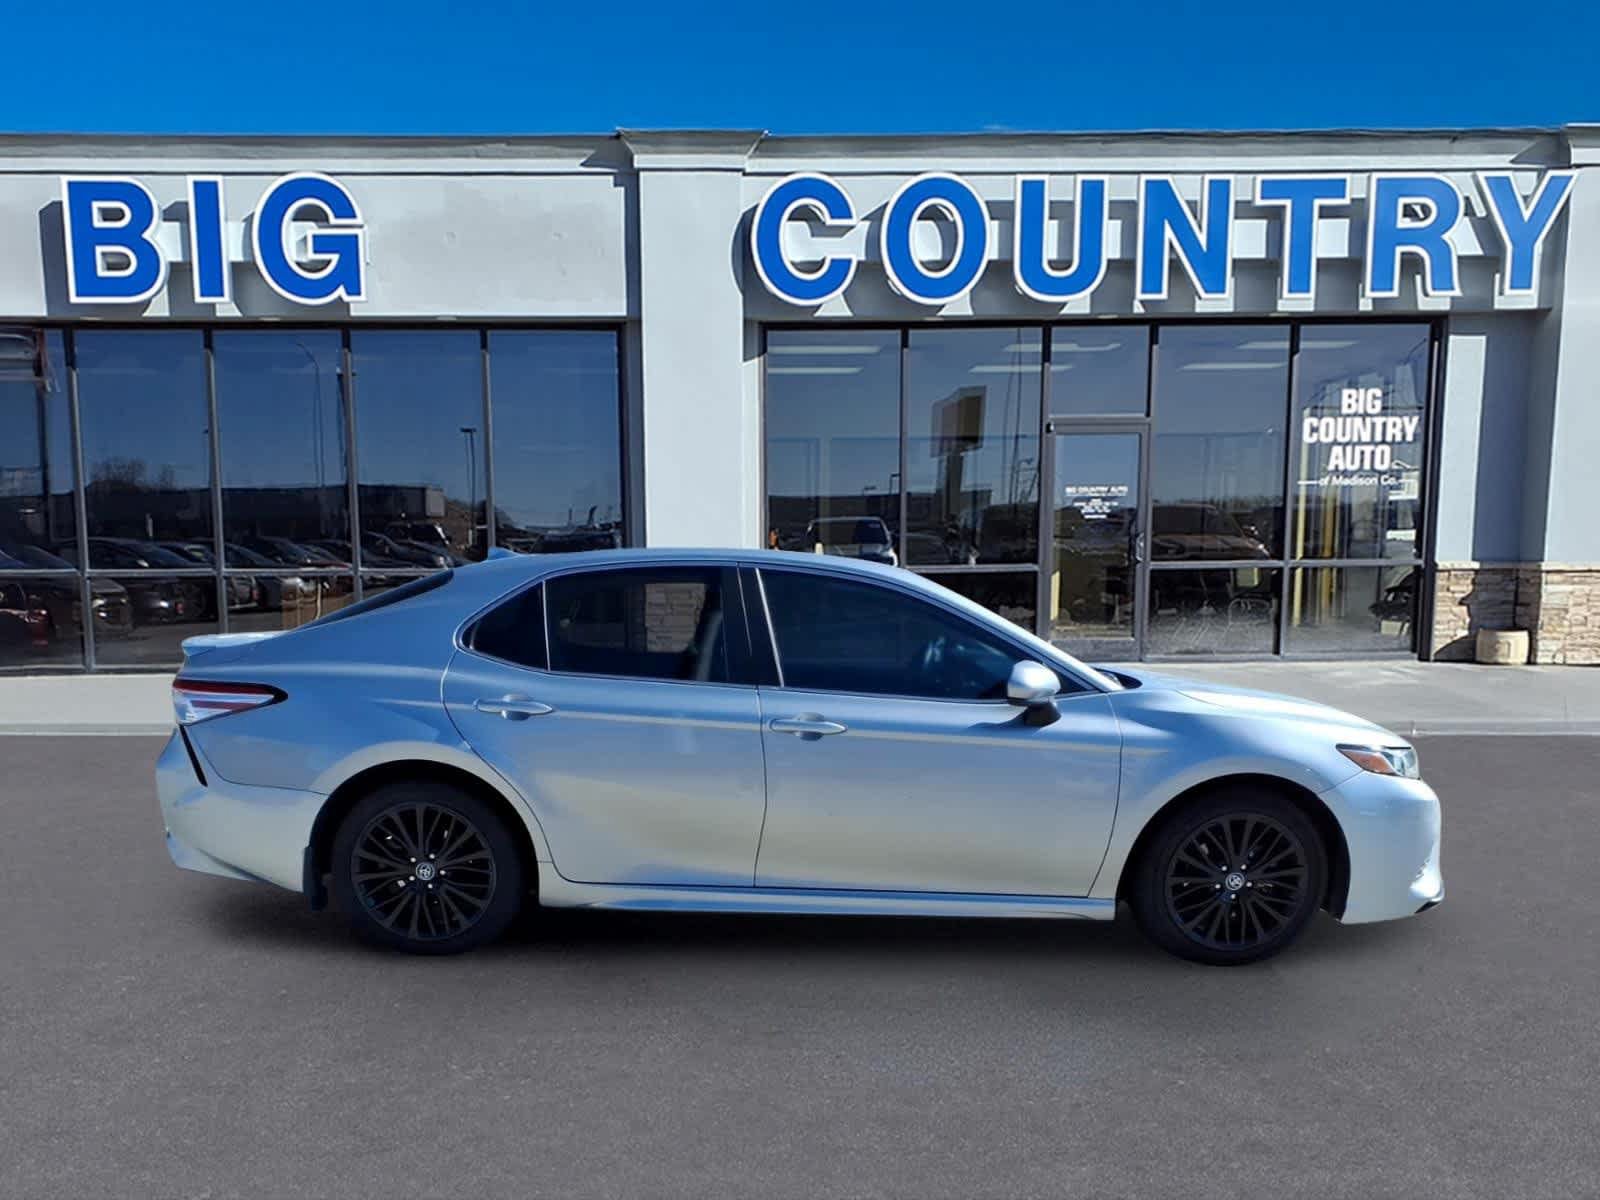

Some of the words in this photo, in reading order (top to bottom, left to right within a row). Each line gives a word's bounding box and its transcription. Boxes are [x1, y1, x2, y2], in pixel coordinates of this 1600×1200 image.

[60, 171, 368, 305] BIG
[749, 169, 1577, 309] COUNTRY
[1341, 388, 1382, 414] BIG
[1303, 416, 1419, 443] COUNTRY
[1328, 445, 1391, 471] AUTO
[1331, 474, 1379, 486] Madison
